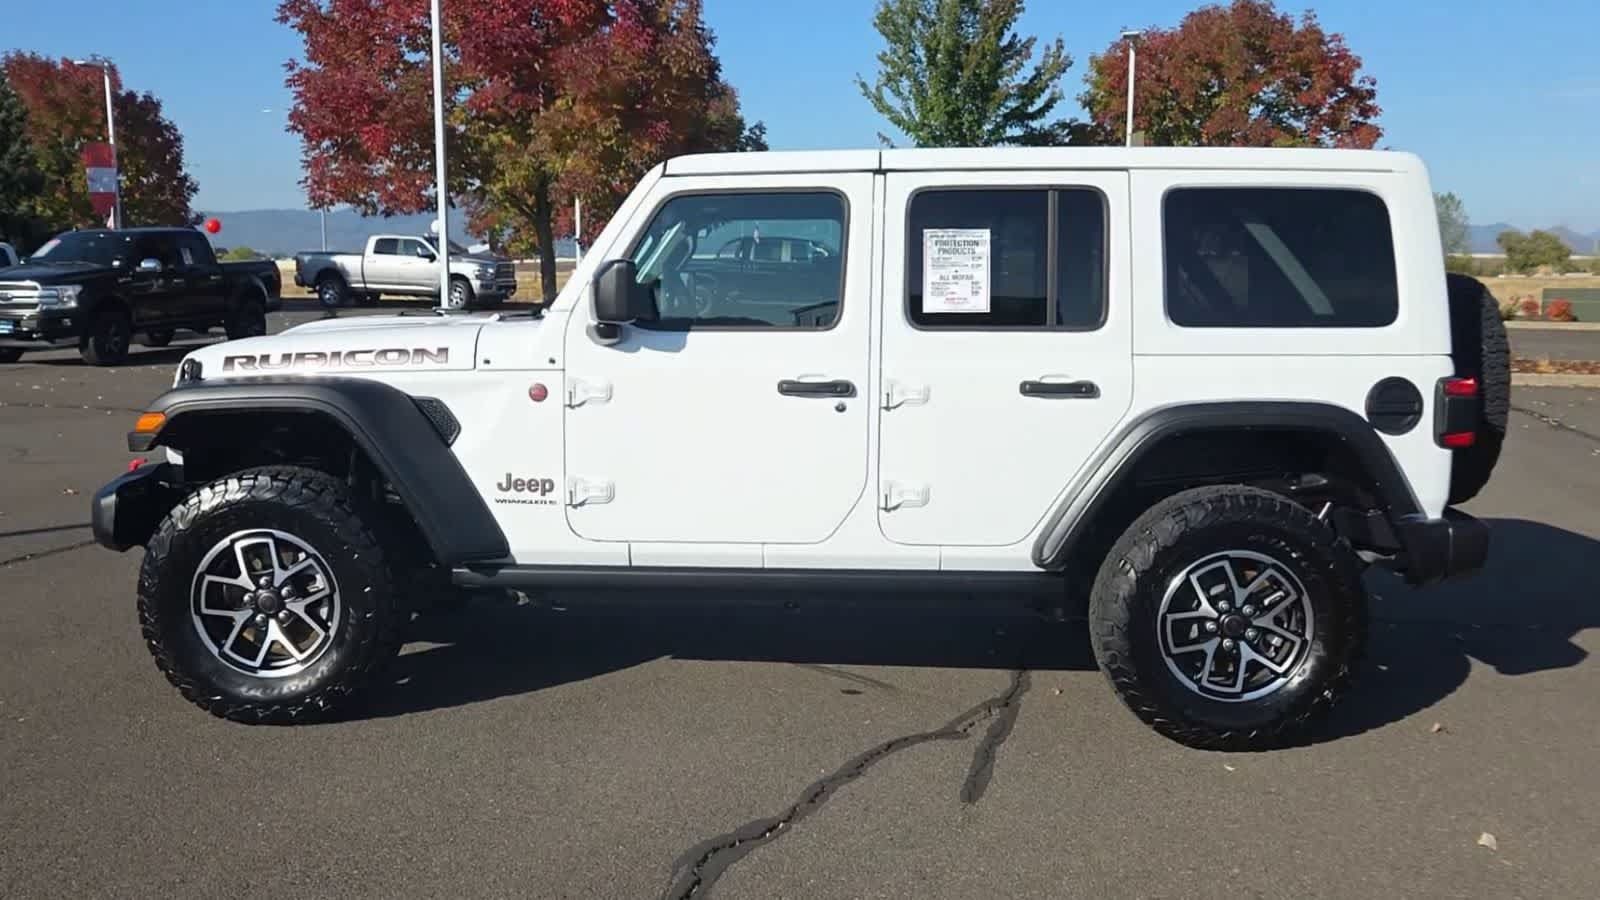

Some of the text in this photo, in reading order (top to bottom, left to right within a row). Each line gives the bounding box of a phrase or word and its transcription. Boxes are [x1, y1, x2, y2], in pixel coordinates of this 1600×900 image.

[938, 247, 976, 255] PRODUCTS
[222, 347, 449, 372] RUBICON
[496, 472, 555, 497] Jeep
